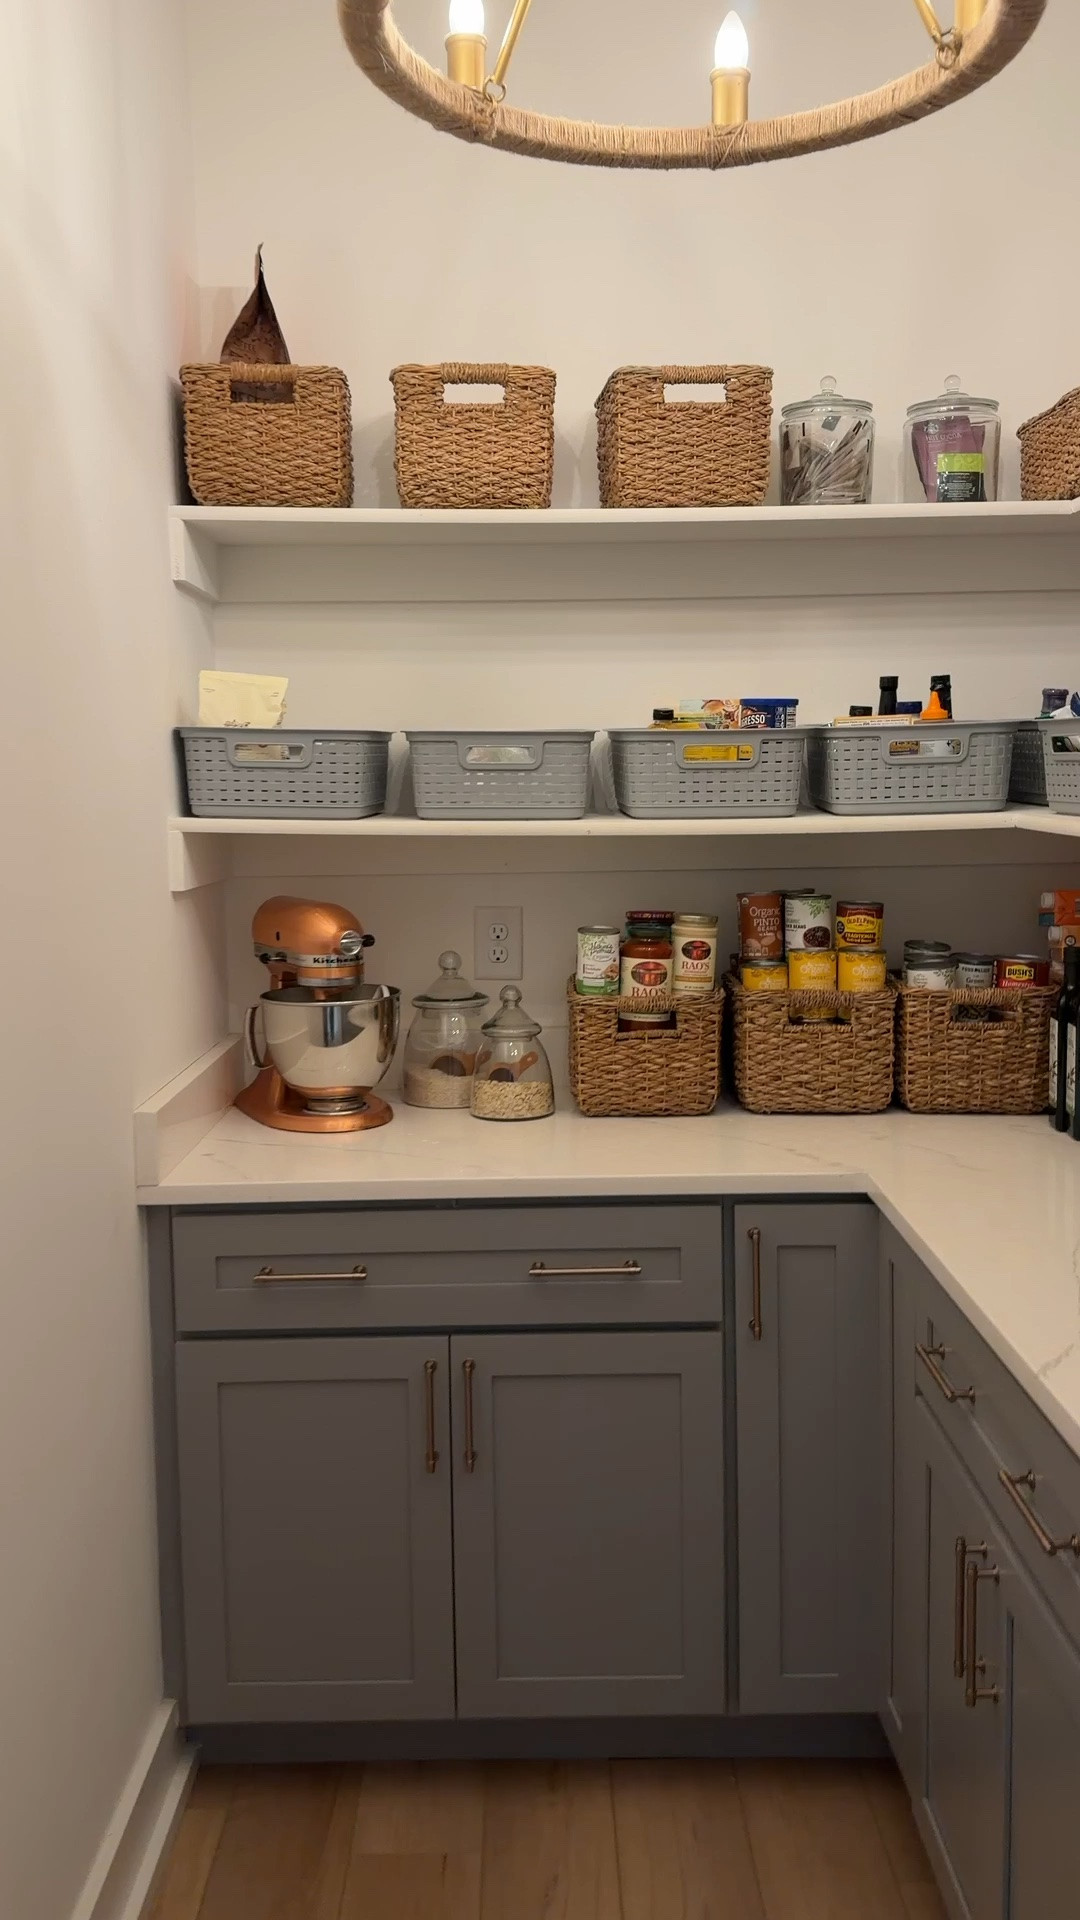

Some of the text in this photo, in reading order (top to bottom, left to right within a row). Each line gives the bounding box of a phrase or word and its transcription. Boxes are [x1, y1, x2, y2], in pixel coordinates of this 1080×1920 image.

[753, 917, 780, 927] PINTO
[681, 961, 710, 970] RAO'S
[1007, 967, 1033, 977] BUSH'S
[632, 986, 667, 998] RAO'S
